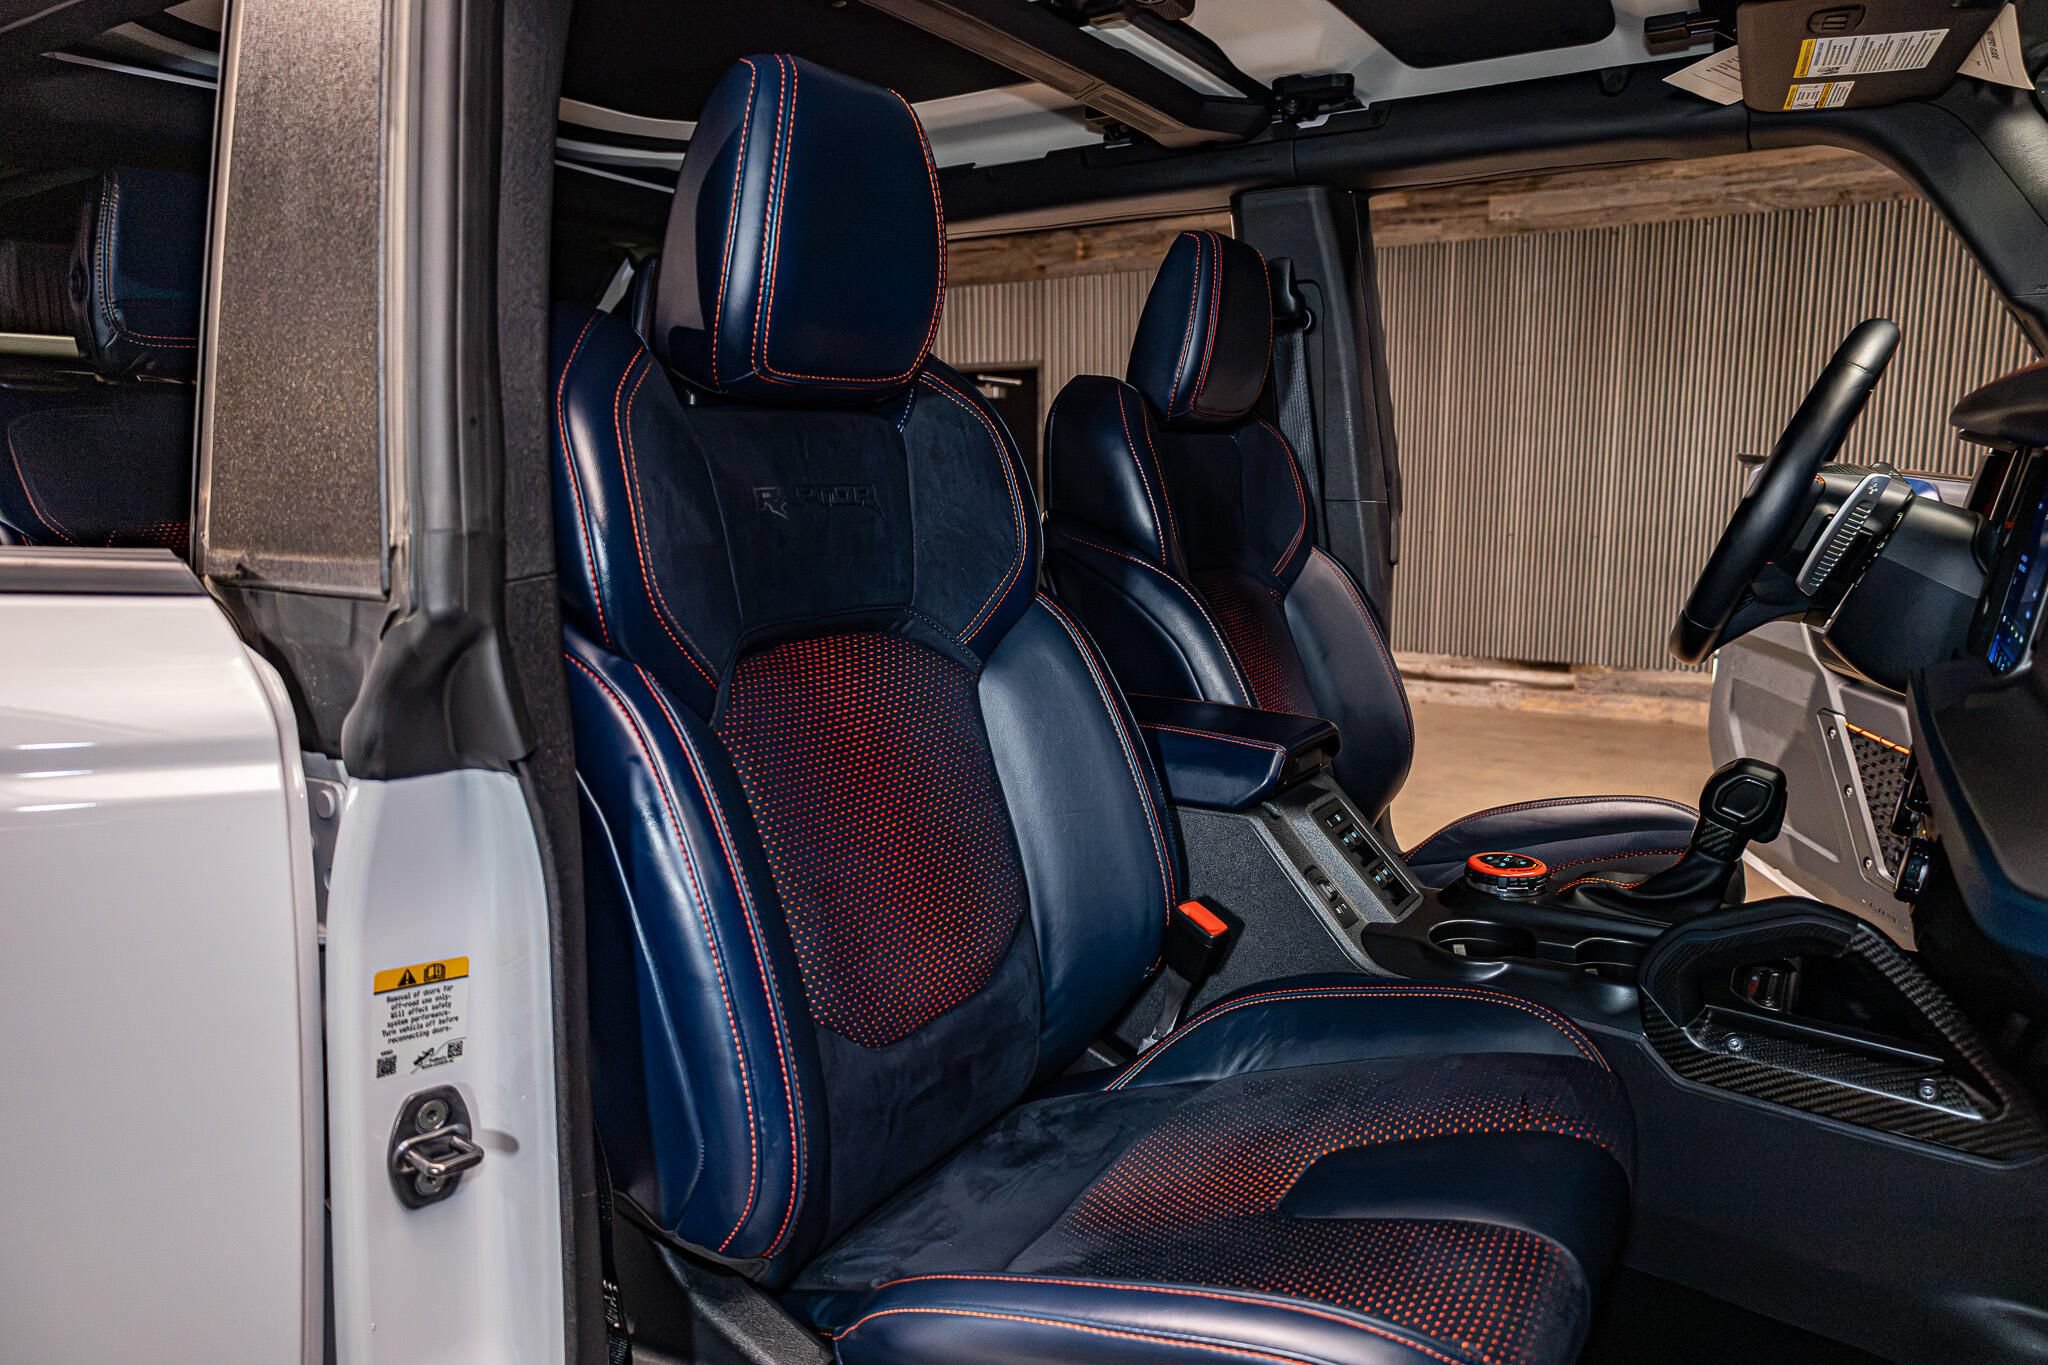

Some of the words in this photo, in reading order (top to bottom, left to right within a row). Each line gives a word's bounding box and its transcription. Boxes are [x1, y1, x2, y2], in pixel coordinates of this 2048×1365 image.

[424, 988, 440, 996] doors
[391, 1000, 419, 1010] off-road
[391, 1011, 404, 1019] Will
[408, 1007, 428, 1015] affect
[432, 1002, 452, 1010] safety
[387, 1019, 408, 1028] system
[400, 1023, 423, 1033] vehicle
[439, 1016, 459, 1024] before
[388, 1030, 429, 1044] reconnecting
